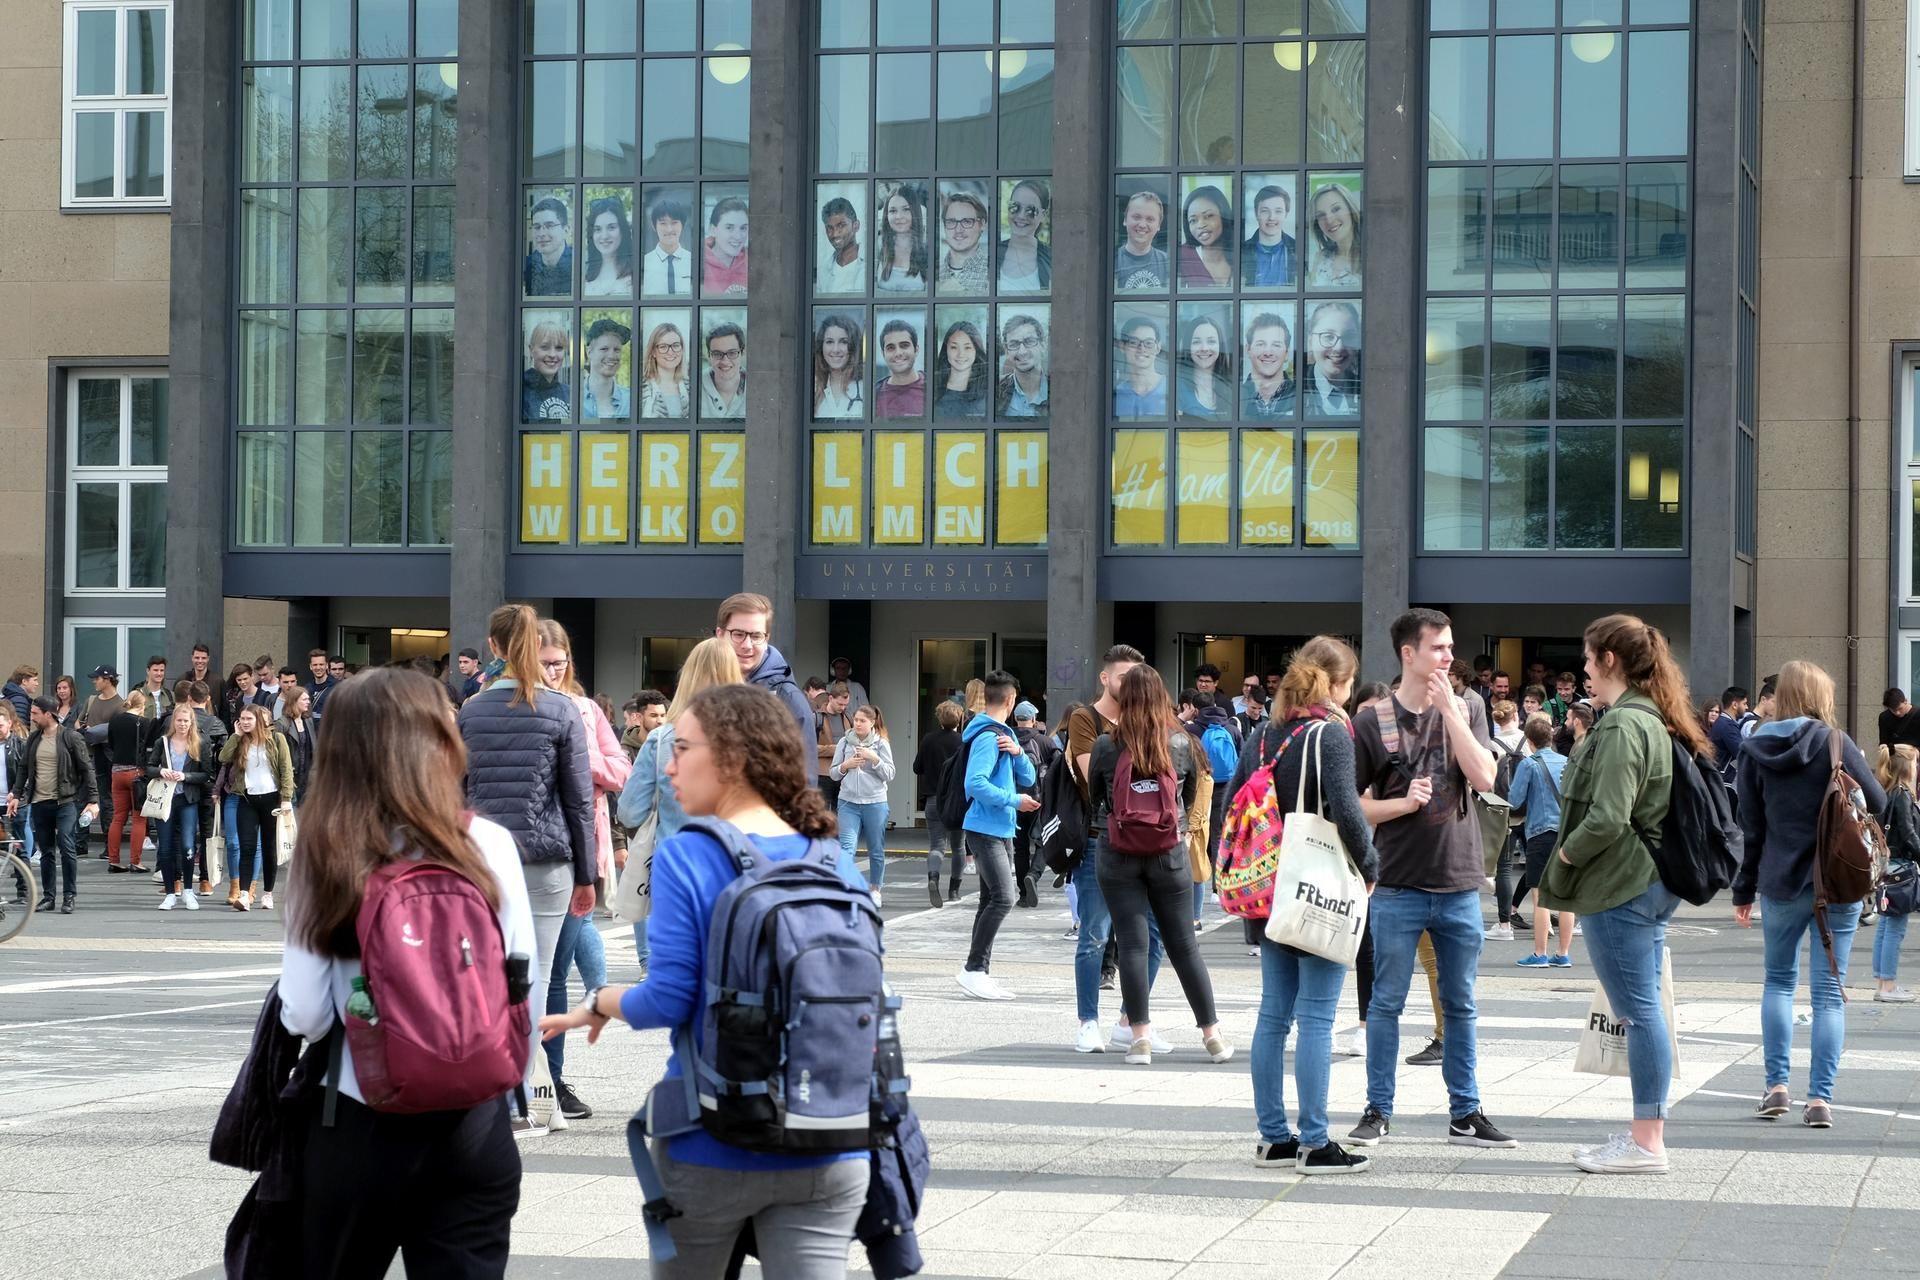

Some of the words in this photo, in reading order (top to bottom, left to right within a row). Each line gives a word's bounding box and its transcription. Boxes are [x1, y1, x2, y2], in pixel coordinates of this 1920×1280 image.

[1243, 520, 1290, 538] SoSe
[1309, 520, 1354, 538] 2018
[823, 561, 1033, 577] UNIVERSITÄT
[842, 580, 1012, 593] HAUPTGEBÄUDE
